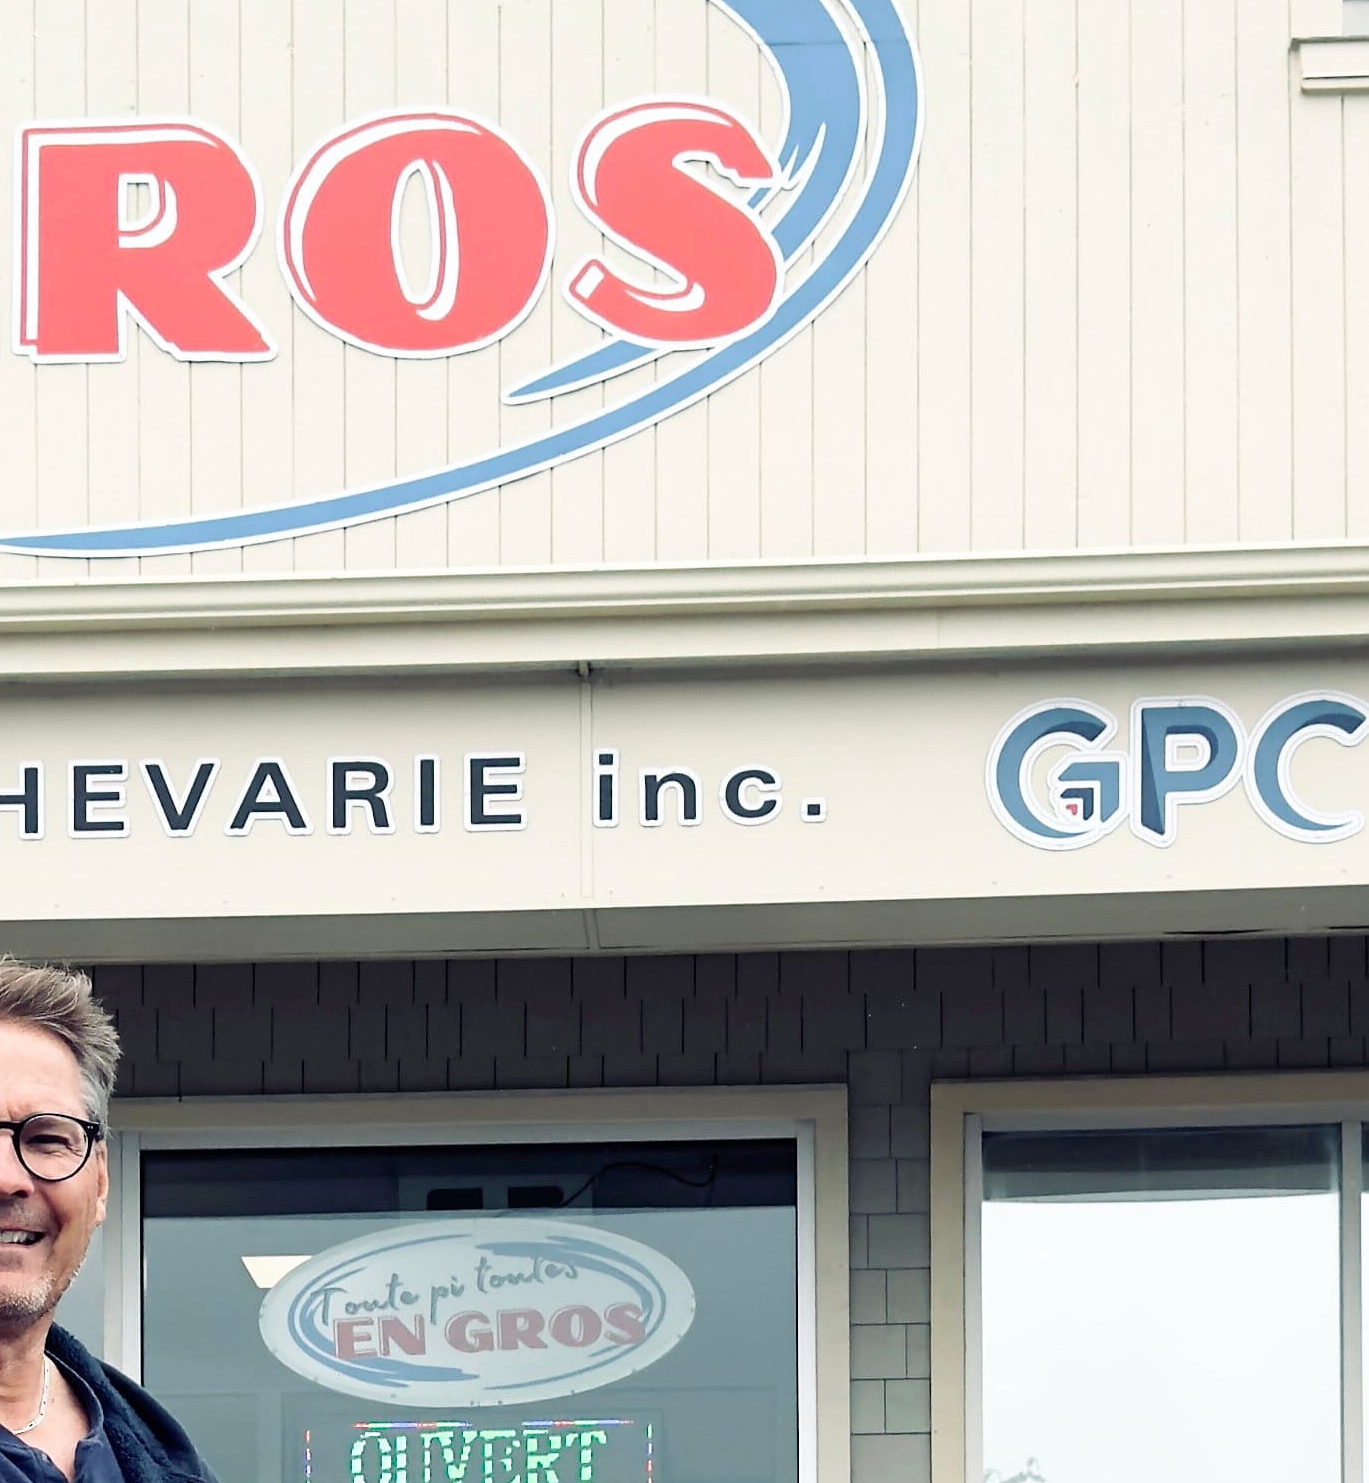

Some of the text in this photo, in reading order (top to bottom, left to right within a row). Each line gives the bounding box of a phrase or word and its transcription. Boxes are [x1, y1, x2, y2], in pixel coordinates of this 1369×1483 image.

[597, 752, 822, 824] inc.
[994, 698, 1368, 842] GPC
[310, 1256, 580, 1327] Toute pi toutes
[333, 1302, 647, 1360] EN GROS
